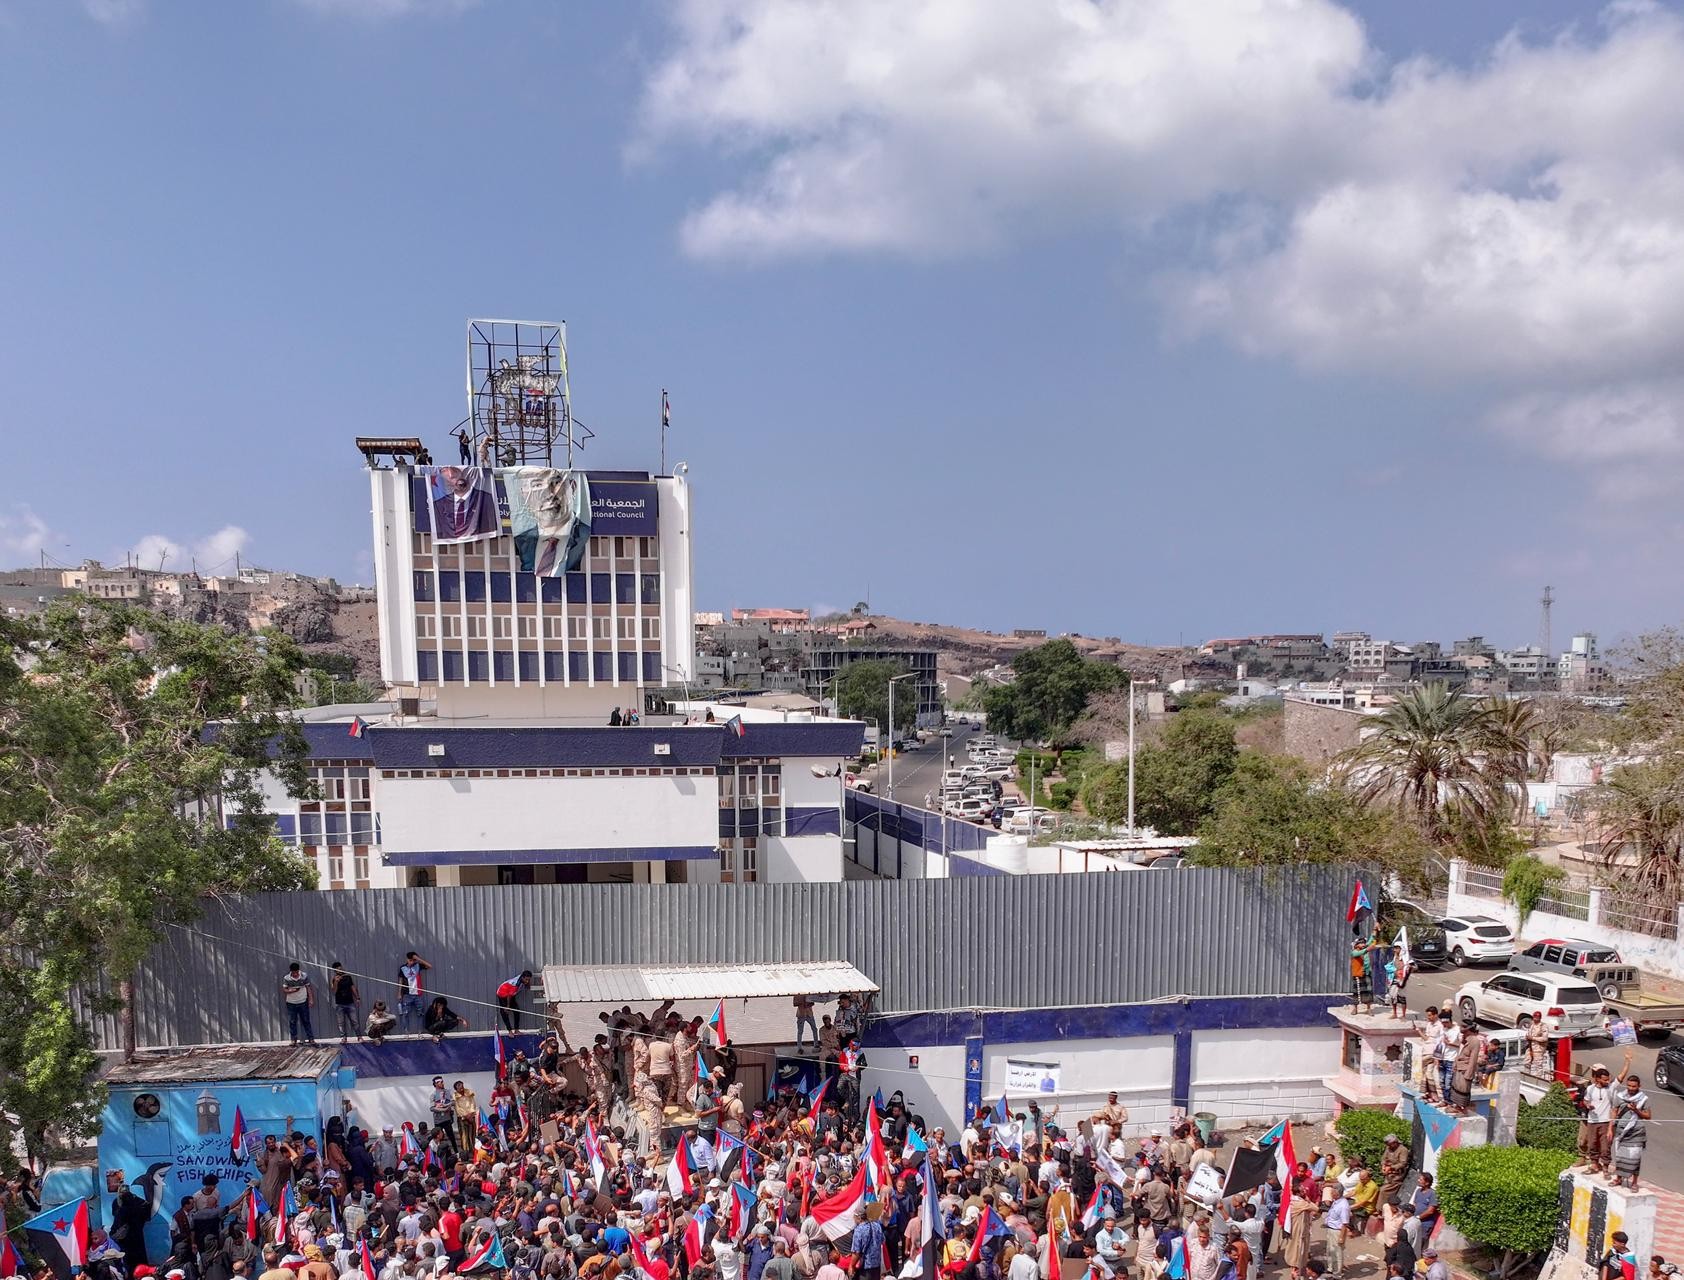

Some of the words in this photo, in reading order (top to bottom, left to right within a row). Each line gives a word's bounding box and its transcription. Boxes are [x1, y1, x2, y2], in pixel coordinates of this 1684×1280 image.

[606, 498, 645, 509] الجمعية
[616, 511, 645, 519] Council
[176, 1155, 250, 1167] SANDWIH
[177, 1168, 206, 1183] FISH
[216, 1168, 253, 1184] CHIPS
